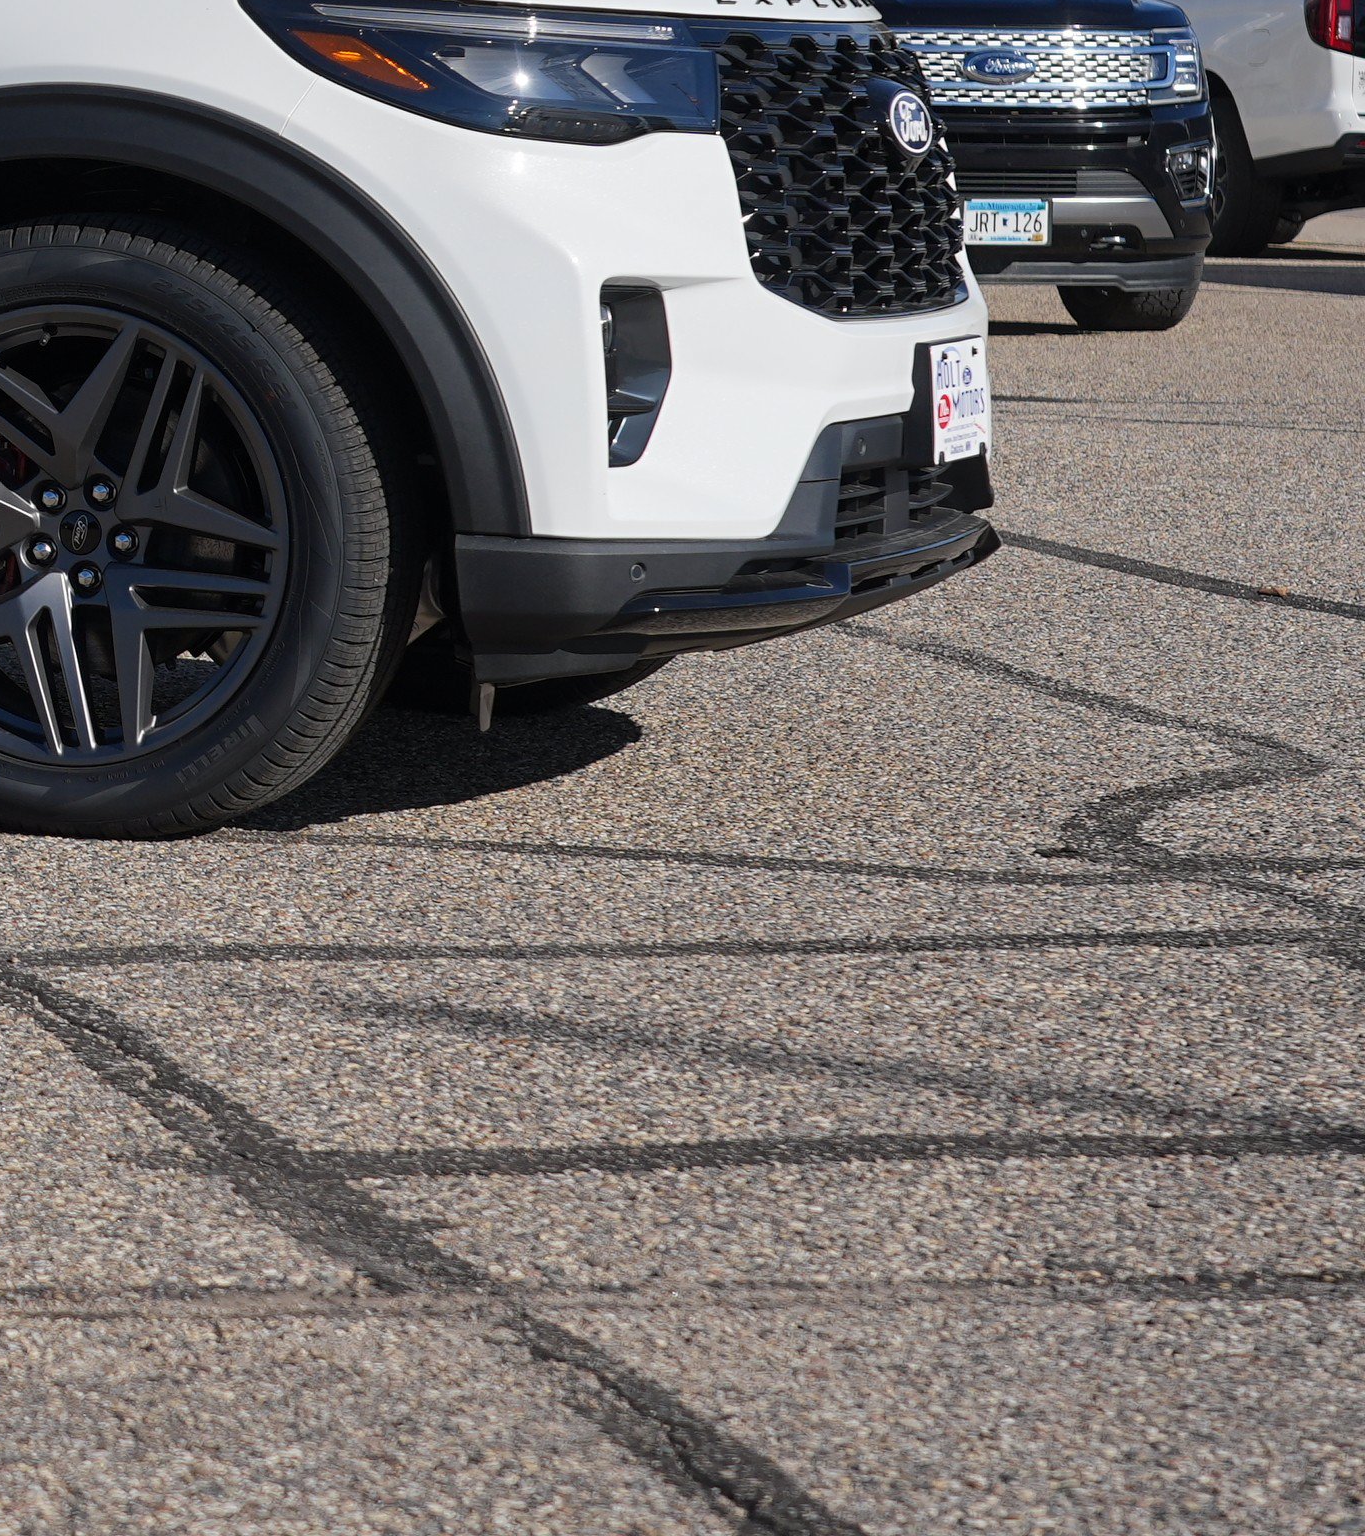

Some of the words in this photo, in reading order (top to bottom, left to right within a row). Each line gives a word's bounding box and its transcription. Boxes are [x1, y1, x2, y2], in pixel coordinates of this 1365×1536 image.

[898, 100, 928, 142] Ford
[969, 212, 999, 233] JRT
[1012, 212, 1042, 233] 126
[936, 360, 961, 390] HOLT
[952, 387, 985, 419] MOTORS
